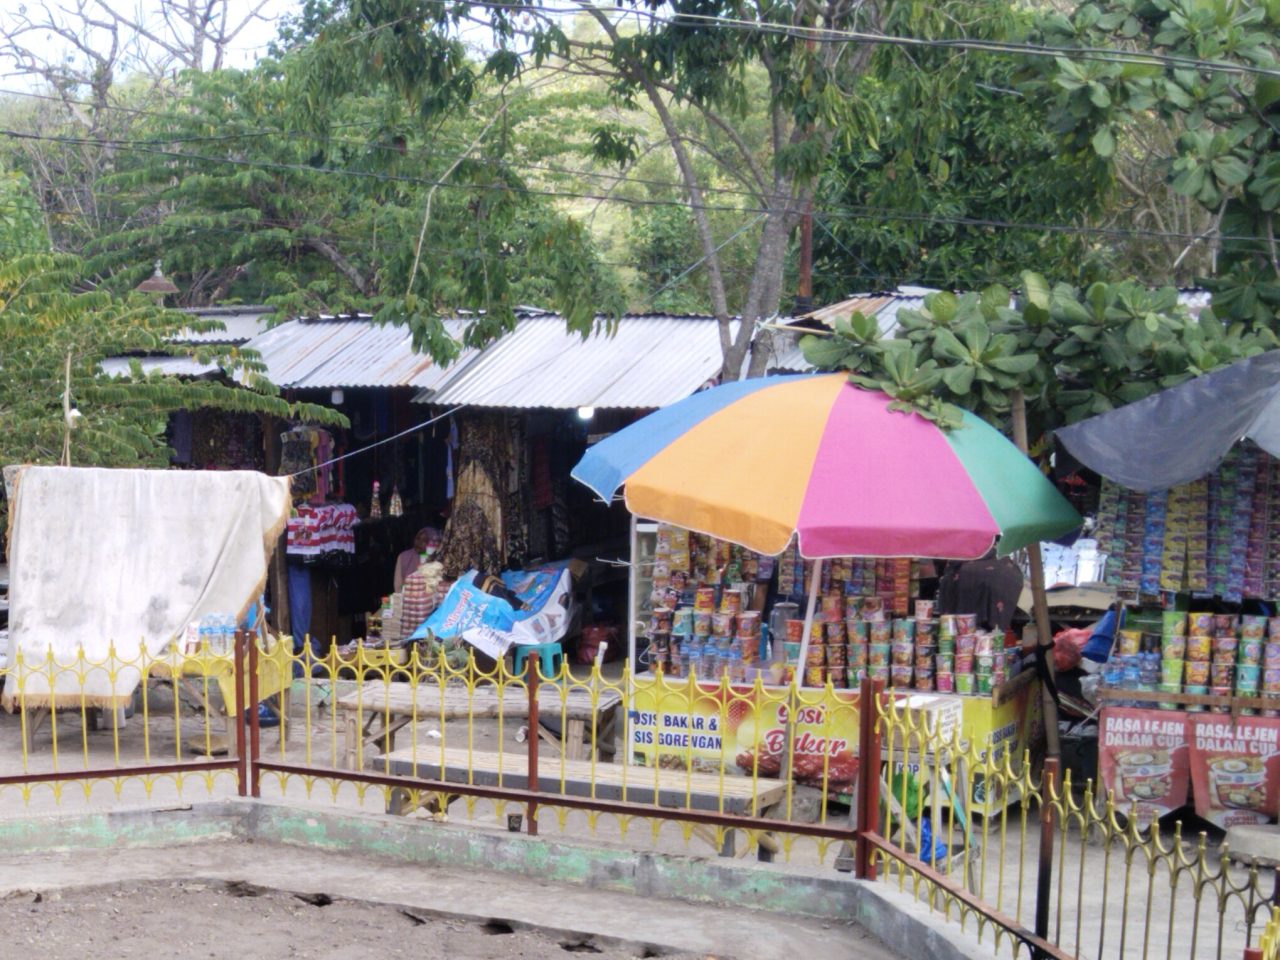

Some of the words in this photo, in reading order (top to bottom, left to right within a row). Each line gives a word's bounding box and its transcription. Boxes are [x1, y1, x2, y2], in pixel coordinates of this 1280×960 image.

[1105, 717, 1140, 733] RASA
[1195, 723, 1233, 739] RASA
[1236, 725, 1278, 743] LEJEN
[1105, 732, 1153, 747] DALAM
[1157, 735, 1185, 749] CUP
[1195, 737, 1246, 753] DALAM
[1249, 741, 1278, 757] CUP
